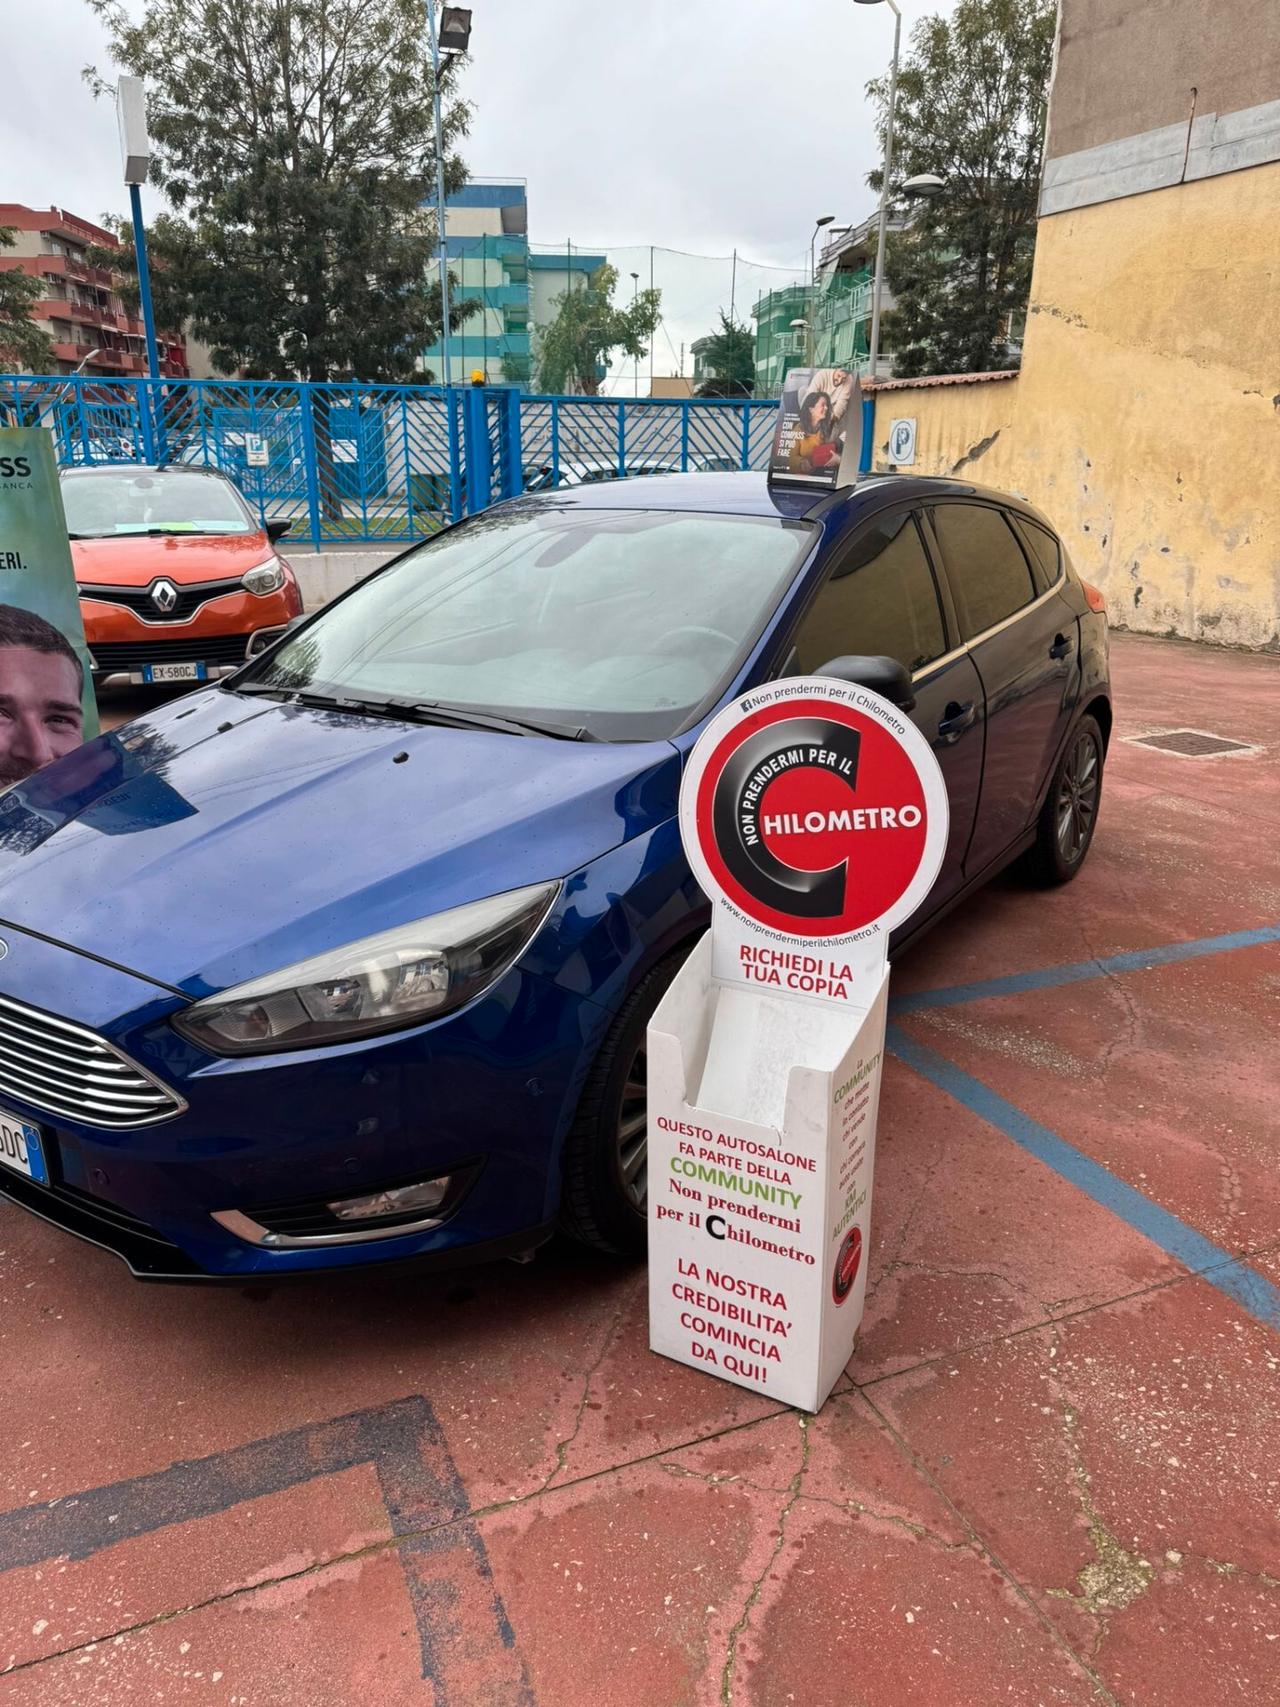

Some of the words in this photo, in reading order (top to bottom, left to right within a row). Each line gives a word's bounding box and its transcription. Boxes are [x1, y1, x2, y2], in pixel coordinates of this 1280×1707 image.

[752, 691, 772, 706] Non
[774, 684, 826, 700] prendermi
[829, 688, 848, 698] per
[850, 691, 856, 701] il
[856, 695, 906, 735] Chilometro
[742, 749, 804, 810] PRENDERMI
[809, 748, 837, 766] PER
[838, 758, 853, 775] IL
[742, 815, 758, 846] NON
[720, 897, 881, 948] www.nonprendermiperilchilometro.it
[740, 945, 823, 975] RICHIEDI
[830, 962, 854, 982] LA
[742, 963, 781, 986] TUA
[786, 974, 848, 1000] COPIA
[834, 1050, 881, 1104] COMMUNITY
[657, 1116, 713, 1142] QUESTO
[716, 1133, 816, 1172] AUTOSALONE
[679, 1141, 696, 1157] FA
[700, 1148, 742, 1170] PARTE
[747, 1161, 792, 1186] DELLA
[669, 1178, 702, 1202] Non
[707, 1194, 801, 1234] prendermi
[670, 1156, 802, 1210] COMMUNITY
[656, 1204, 684, 1222] per
[688, 1212, 700, 1228] il
[706, 1214, 816, 1266] Chilometro
[678, 1258, 700, 1280] LA
[706, 1268, 788, 1310] NOSTRA
[680, 1312, 782, 1362] COMINCIA
[692, 1342, 718, 1365] DA
[724, 1355, 767, 1384] QUI!
